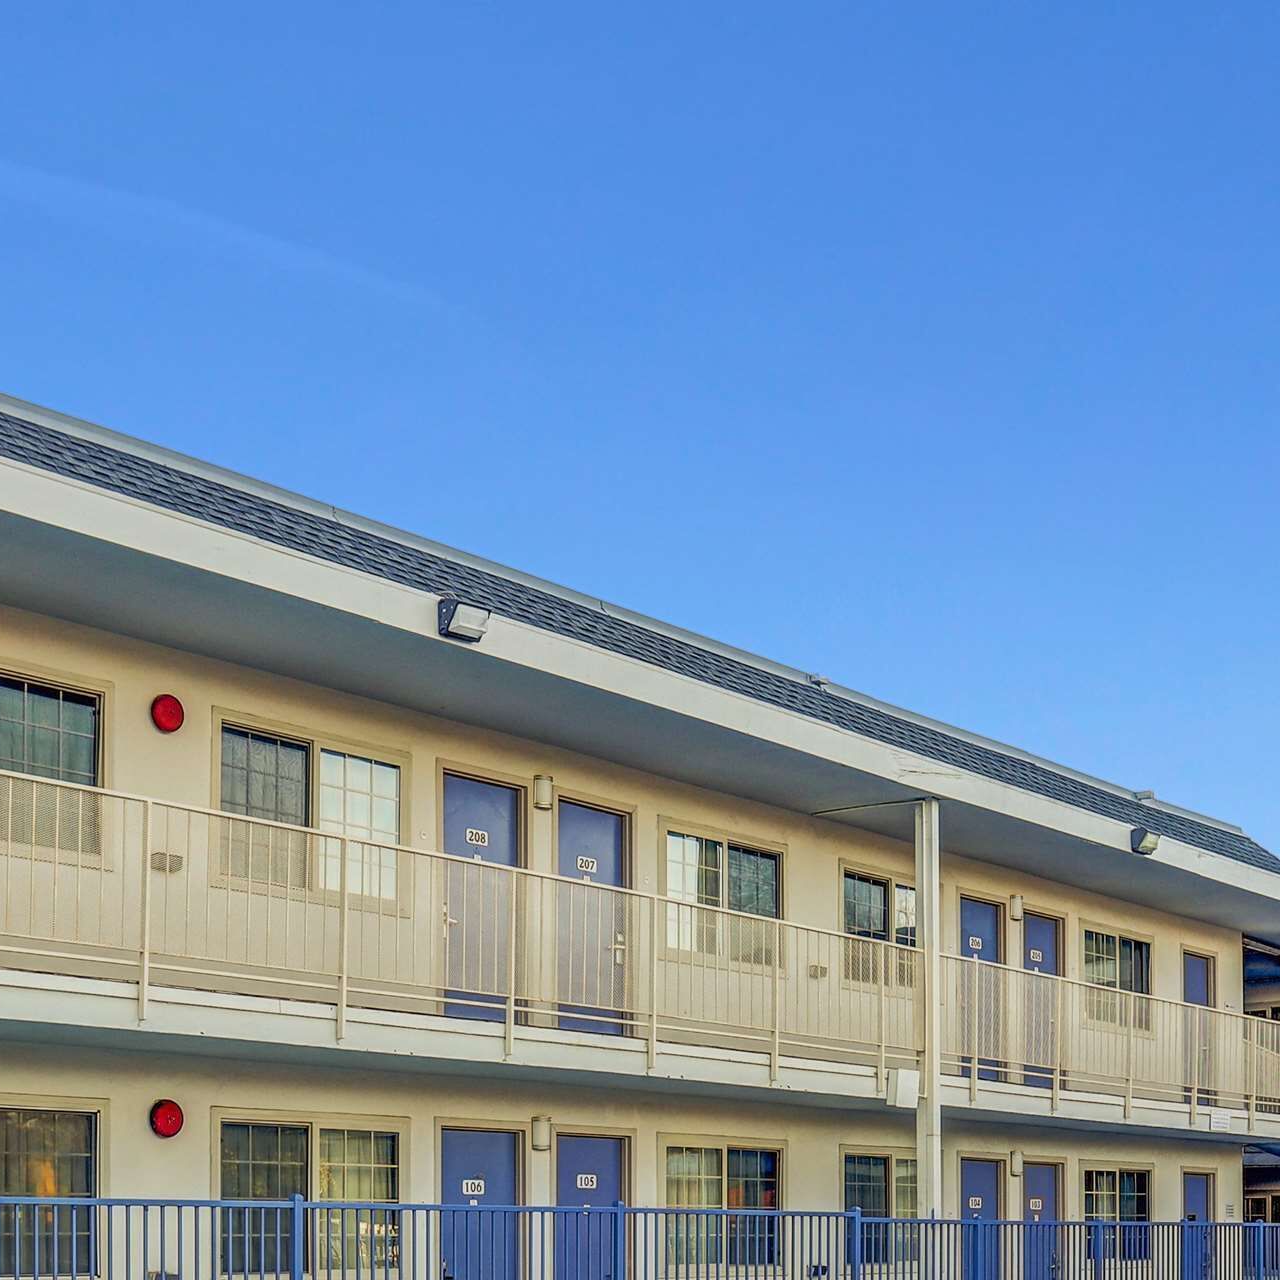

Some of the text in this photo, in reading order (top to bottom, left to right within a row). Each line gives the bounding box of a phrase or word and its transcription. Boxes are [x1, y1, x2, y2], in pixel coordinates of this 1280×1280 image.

[468, 830, 486, 844] 208
[579, 858, 595, 870] 207
[465, 1181, 482, 1193] 106
[579, 1175, 595, 1187] 105
[970, 1198, 981, 1208] 104
